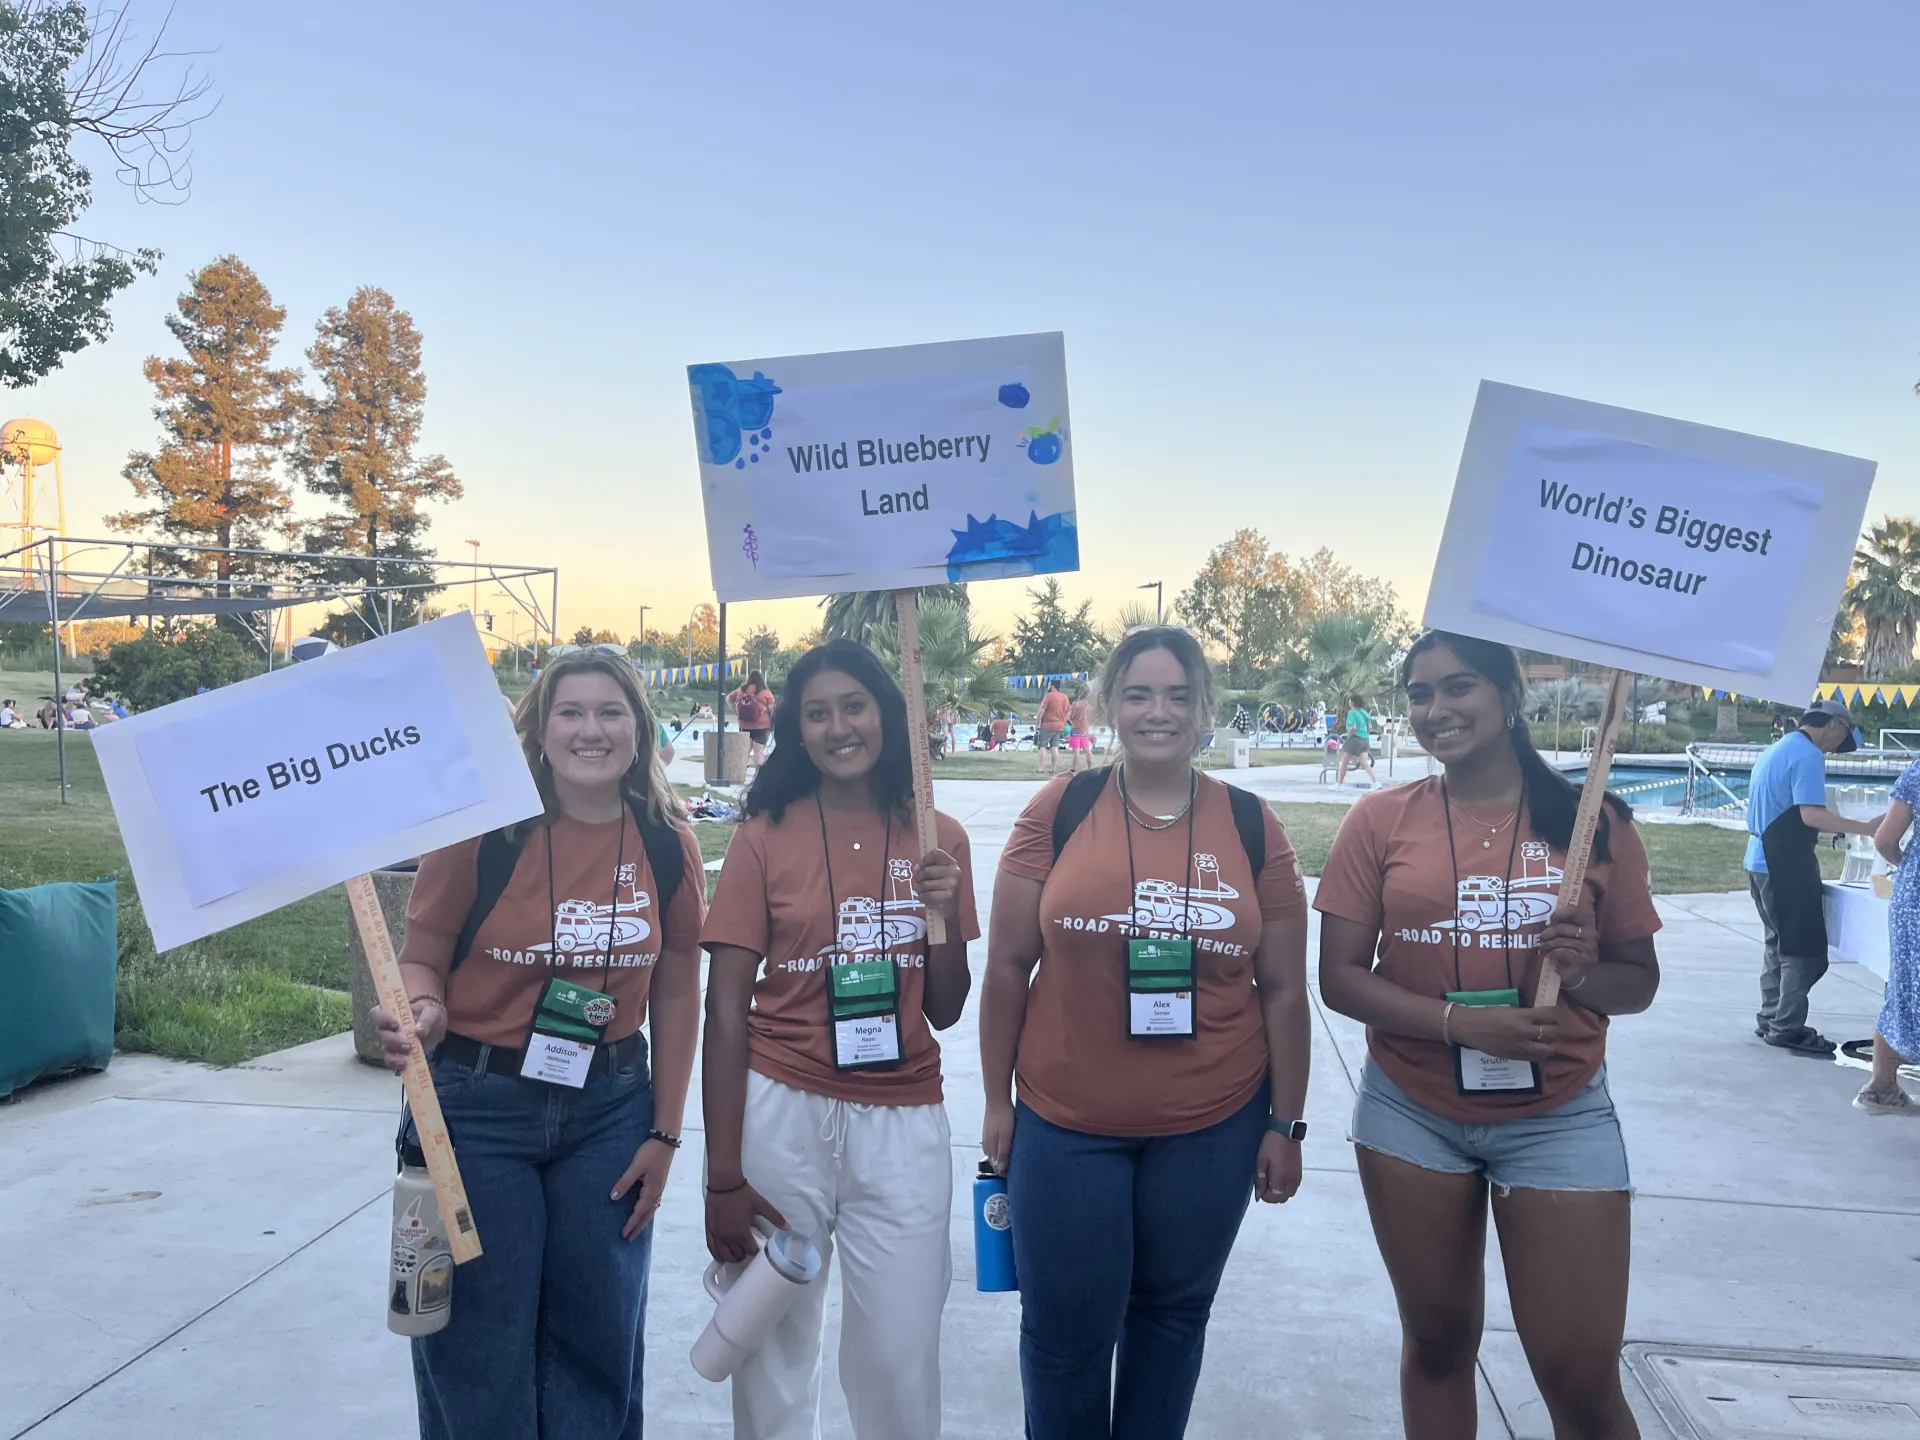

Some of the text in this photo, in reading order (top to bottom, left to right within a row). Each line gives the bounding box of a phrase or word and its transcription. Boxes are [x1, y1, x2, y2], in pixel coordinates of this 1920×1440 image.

[787, 434, 991, 473] Wild Blueberry
[861, 483, 930, 516] Land
[1540, 478, 1773, 556] World's Biggest
[1571, 541, 1707, 596] Dinosaur
[199, 725, 421, 813] The Big Ducks
[919, 719, 933, 811] The helpful place.
[1526, 848, 1545, 857] 24
[1572, 847, 1588, 886] helpful
[1583, 812, 1597, 845] place.
[1199, 860, 1215, 869] 24
[618, 871, 633, 882] 24
[893, 867, 909, 878] 24
[1118, 923, 1140, 937] TO
[1449, 931, 1472, 947] TO
[543, 954, 566, 967] TO
[828, 953, 848, 967] TO
[591, 1003, 610, 1013] She
[1153, 1000, 1171, 1008] Alex
[855, 1026, 882, 1036] Megna
[544, 1043, 578, 1058] Addison
